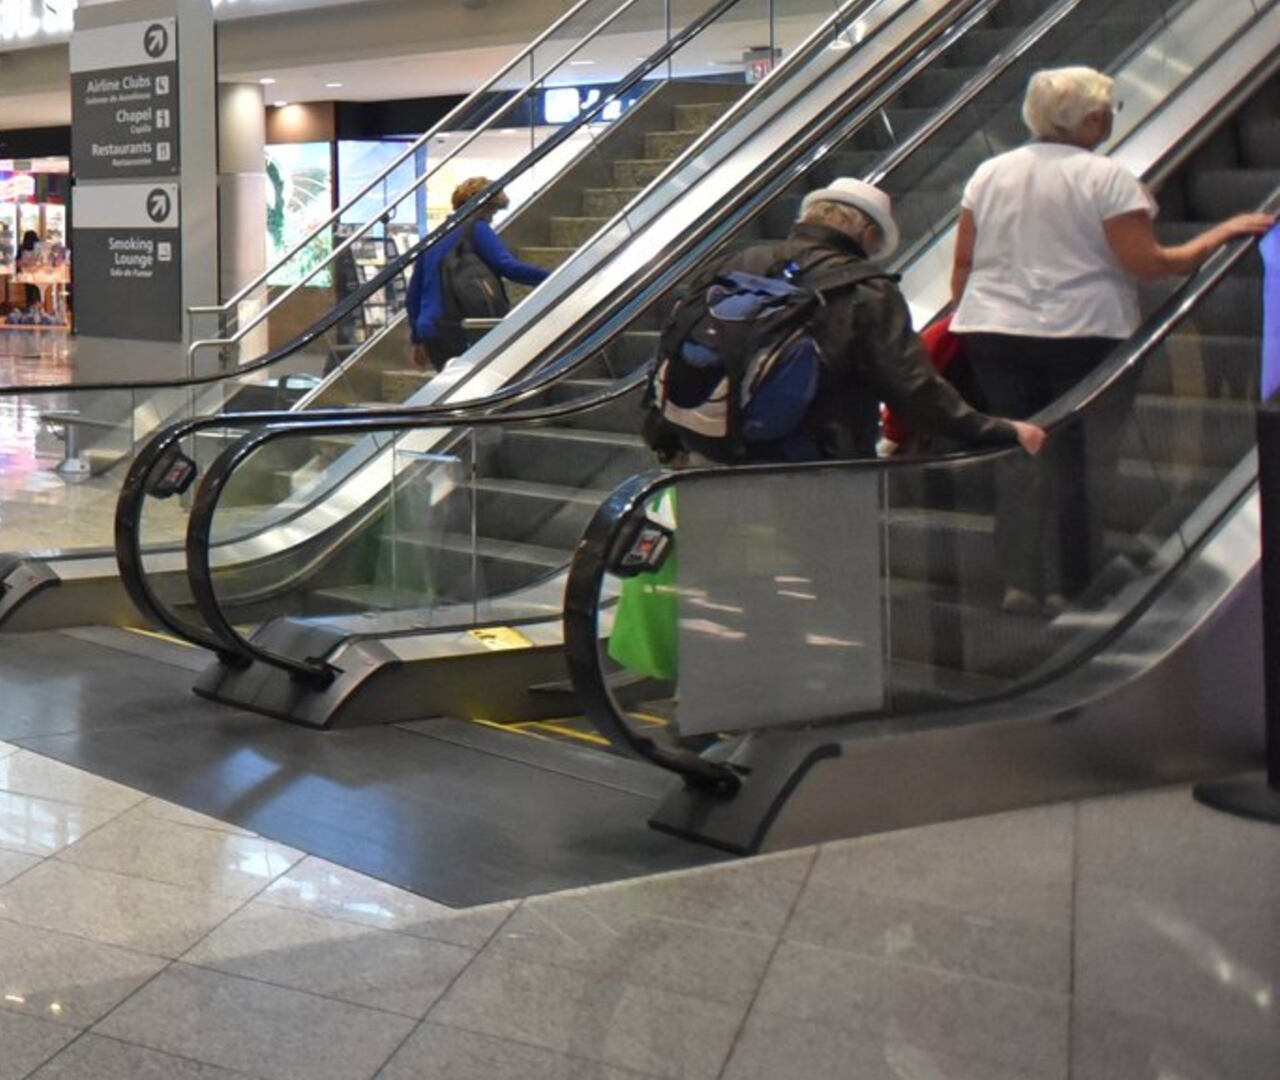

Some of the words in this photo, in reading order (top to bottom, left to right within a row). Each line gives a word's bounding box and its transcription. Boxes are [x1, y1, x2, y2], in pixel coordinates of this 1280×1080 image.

[86, 79, 120, 93] Airline
[122, 75, 151, 89] Clubs
[116, 107, 152, 124] Chapel
[92, 142, 152, 156] Restaurants
[108, 236, 153, 254] Smoking
[114, 252, 153, 269] Lounge
